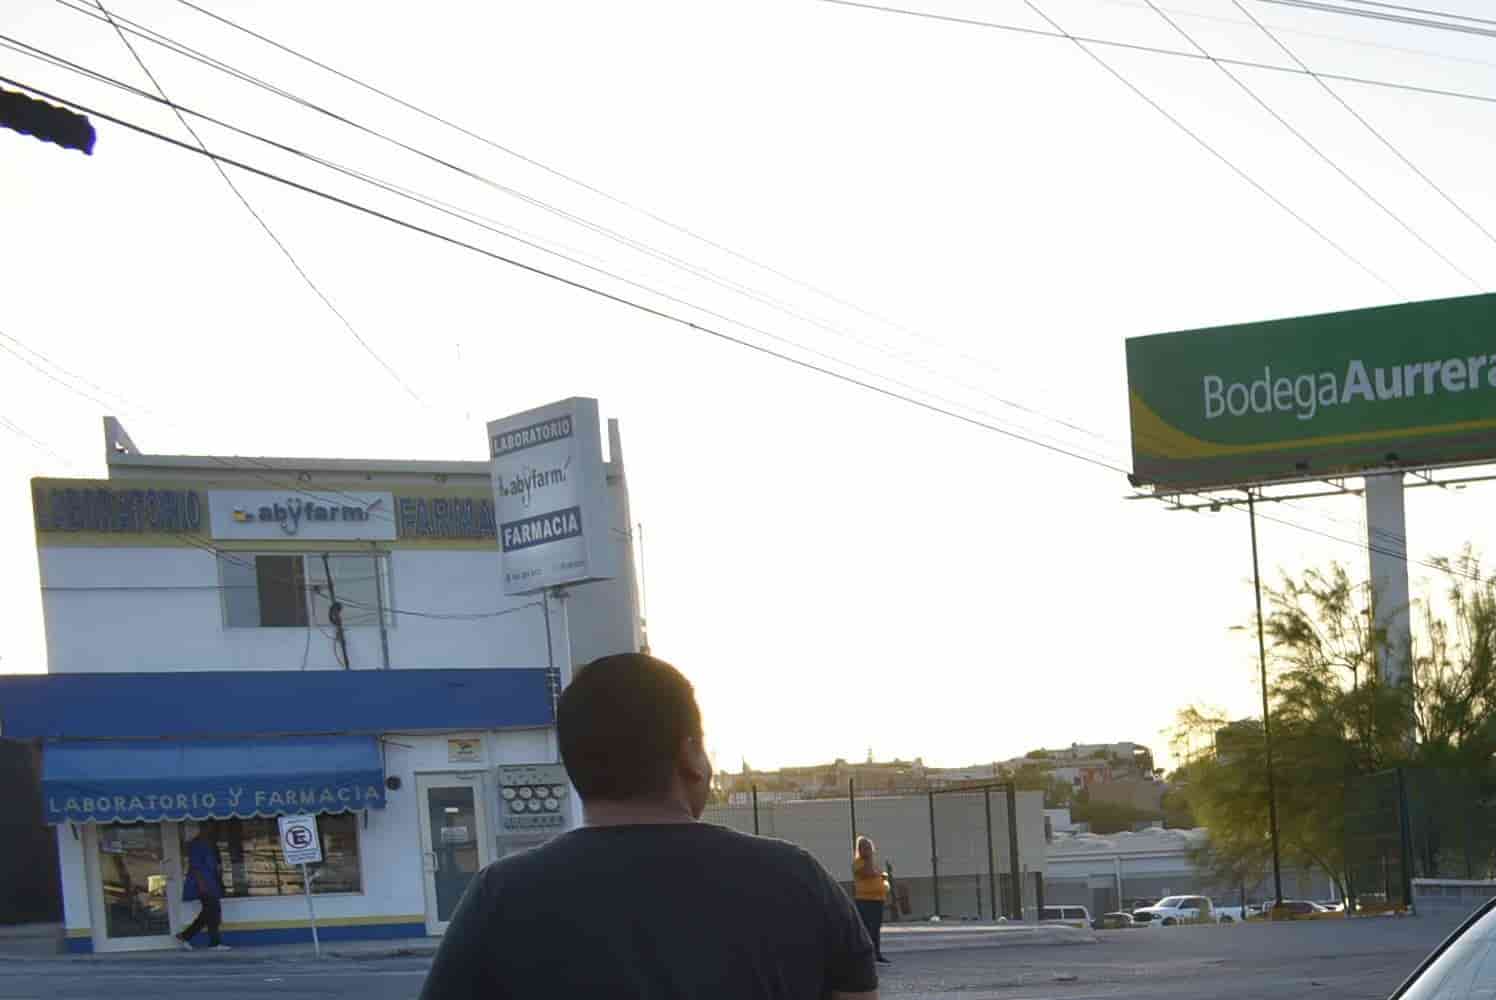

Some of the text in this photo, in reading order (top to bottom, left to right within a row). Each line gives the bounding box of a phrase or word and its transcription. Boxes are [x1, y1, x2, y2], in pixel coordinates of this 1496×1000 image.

[495, 418, 571, 453] LABORATORIO
[401, 498, 495, 537] FARMA
[505, 512, 578, 547] FARMACIA
[50, 785, 379, 814] LABORATORIO Y FARMACIA
